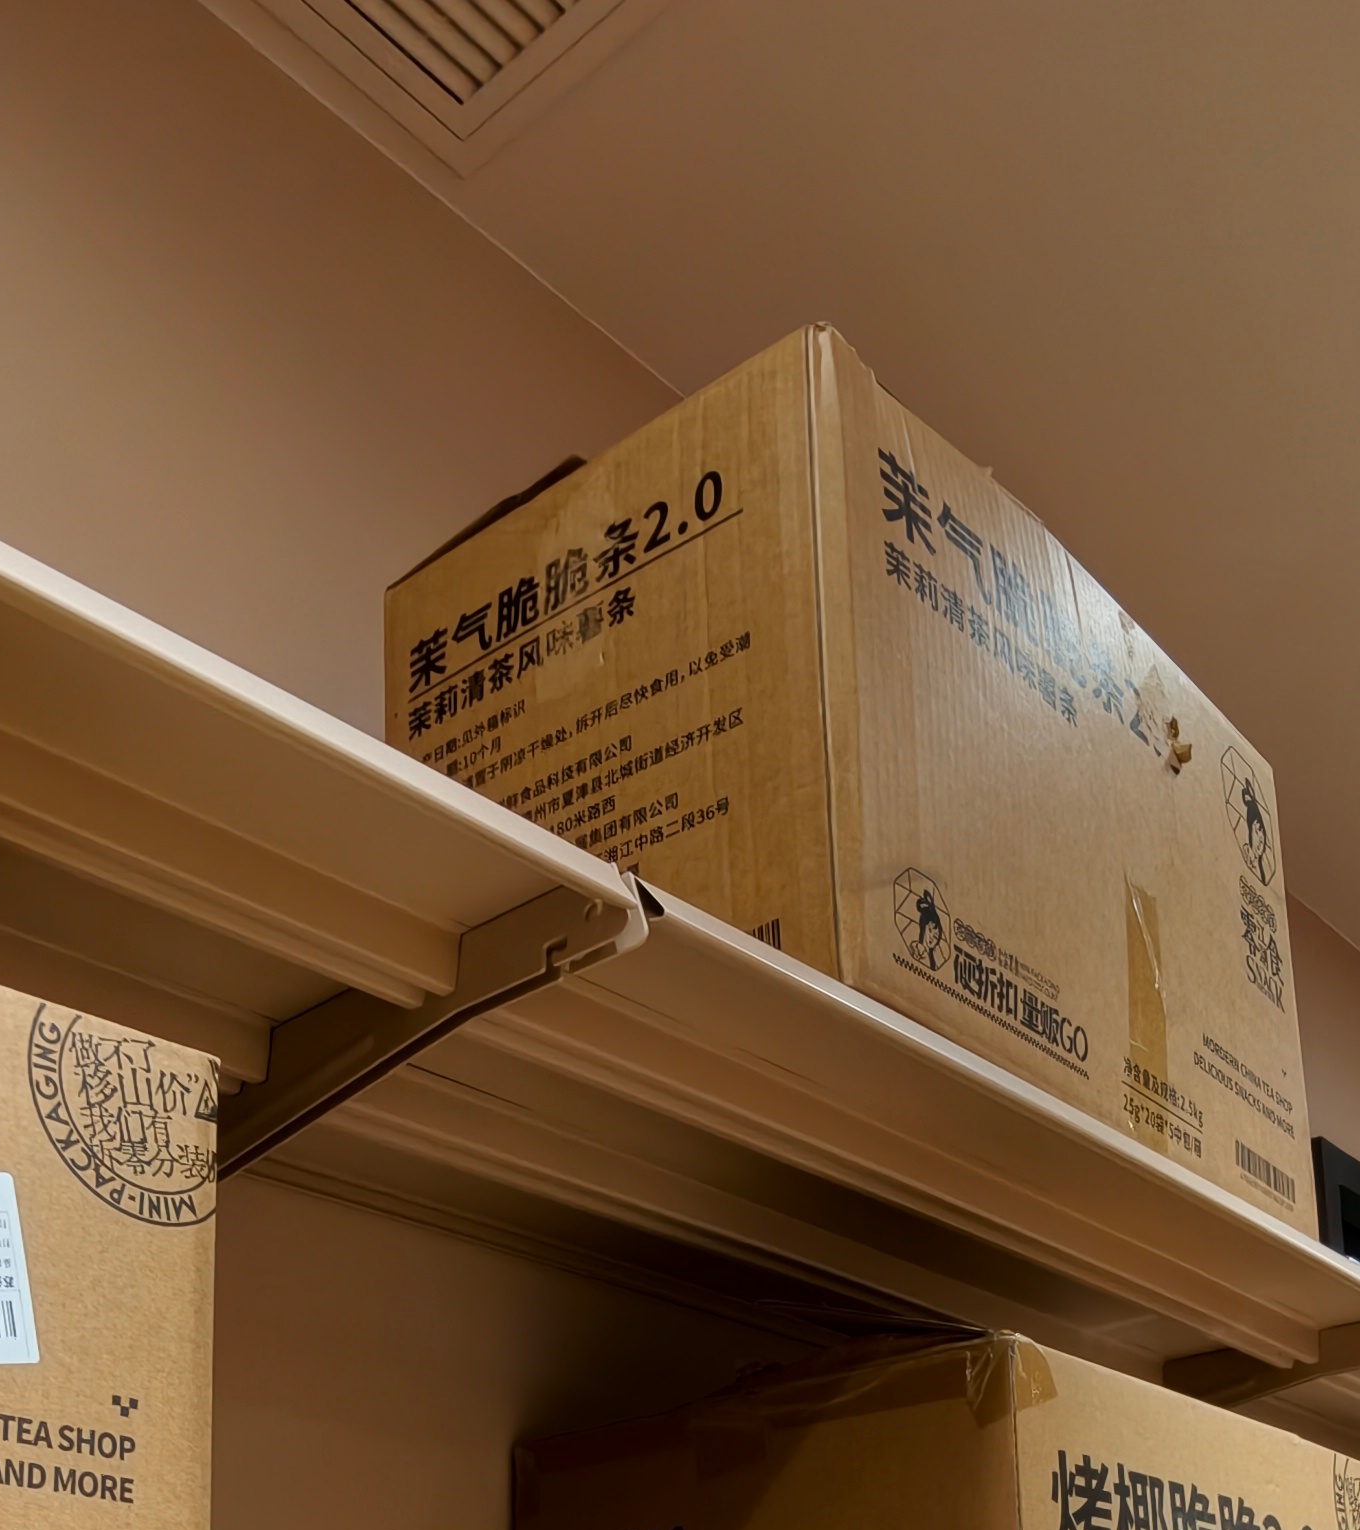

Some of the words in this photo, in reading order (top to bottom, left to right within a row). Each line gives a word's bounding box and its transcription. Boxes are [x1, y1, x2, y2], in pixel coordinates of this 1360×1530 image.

[409, 470, 725, 694] 茉气脆脆条2.0
[1193, 1051, 1234, 1092] DELICIOUS
[1234, 1080, 1262, 1114] SNACKS
[1202, 1032, 1240, 1073] MORDERN
[1240, 1062, 1262, 1090] CHINA
[1262, 1078, 1275, 1100] TEA
[1275, 1091, 1293, 1115] SHOP
[58, 1422, 137, 1462] SHOP
[53, 1466, 136, 1505] MORE
